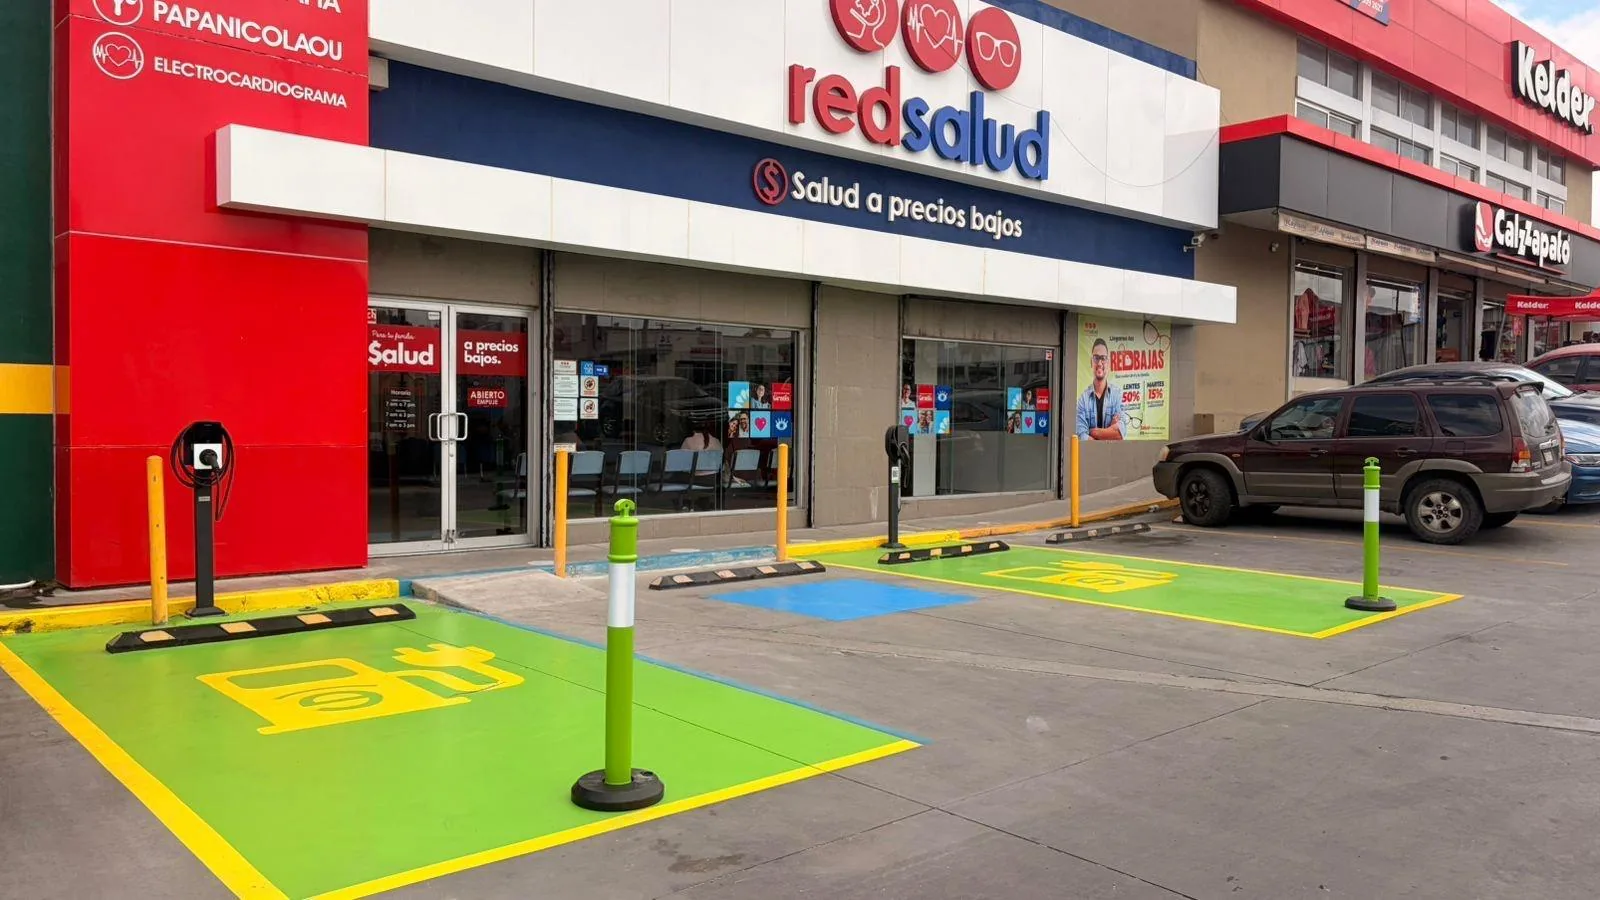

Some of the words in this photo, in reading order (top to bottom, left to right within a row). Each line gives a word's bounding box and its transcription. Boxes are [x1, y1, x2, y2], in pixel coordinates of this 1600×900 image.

[153, 1, 342, 61] PAPANICOLAOU
[154, 56, 348, 108] ELECTROCARDIOGRAMA
[789, 64, 1050, 181] redsalud
[791, 171, 860, 209] Salud
[866, 192, 882, 213] a
[888, 195, 966, 228] precios
[970, 205, 1022, 240] bajos
[1495, 208, 1571, 267] Calzzapato
[464, 341, 473, 350] a
[476, 339, 519, 354] precios
[464, 350, 502, 367] bajos.
[470, 390, 505, 400] ABIERTO
[1122, 391, 1140, 402] 50%
